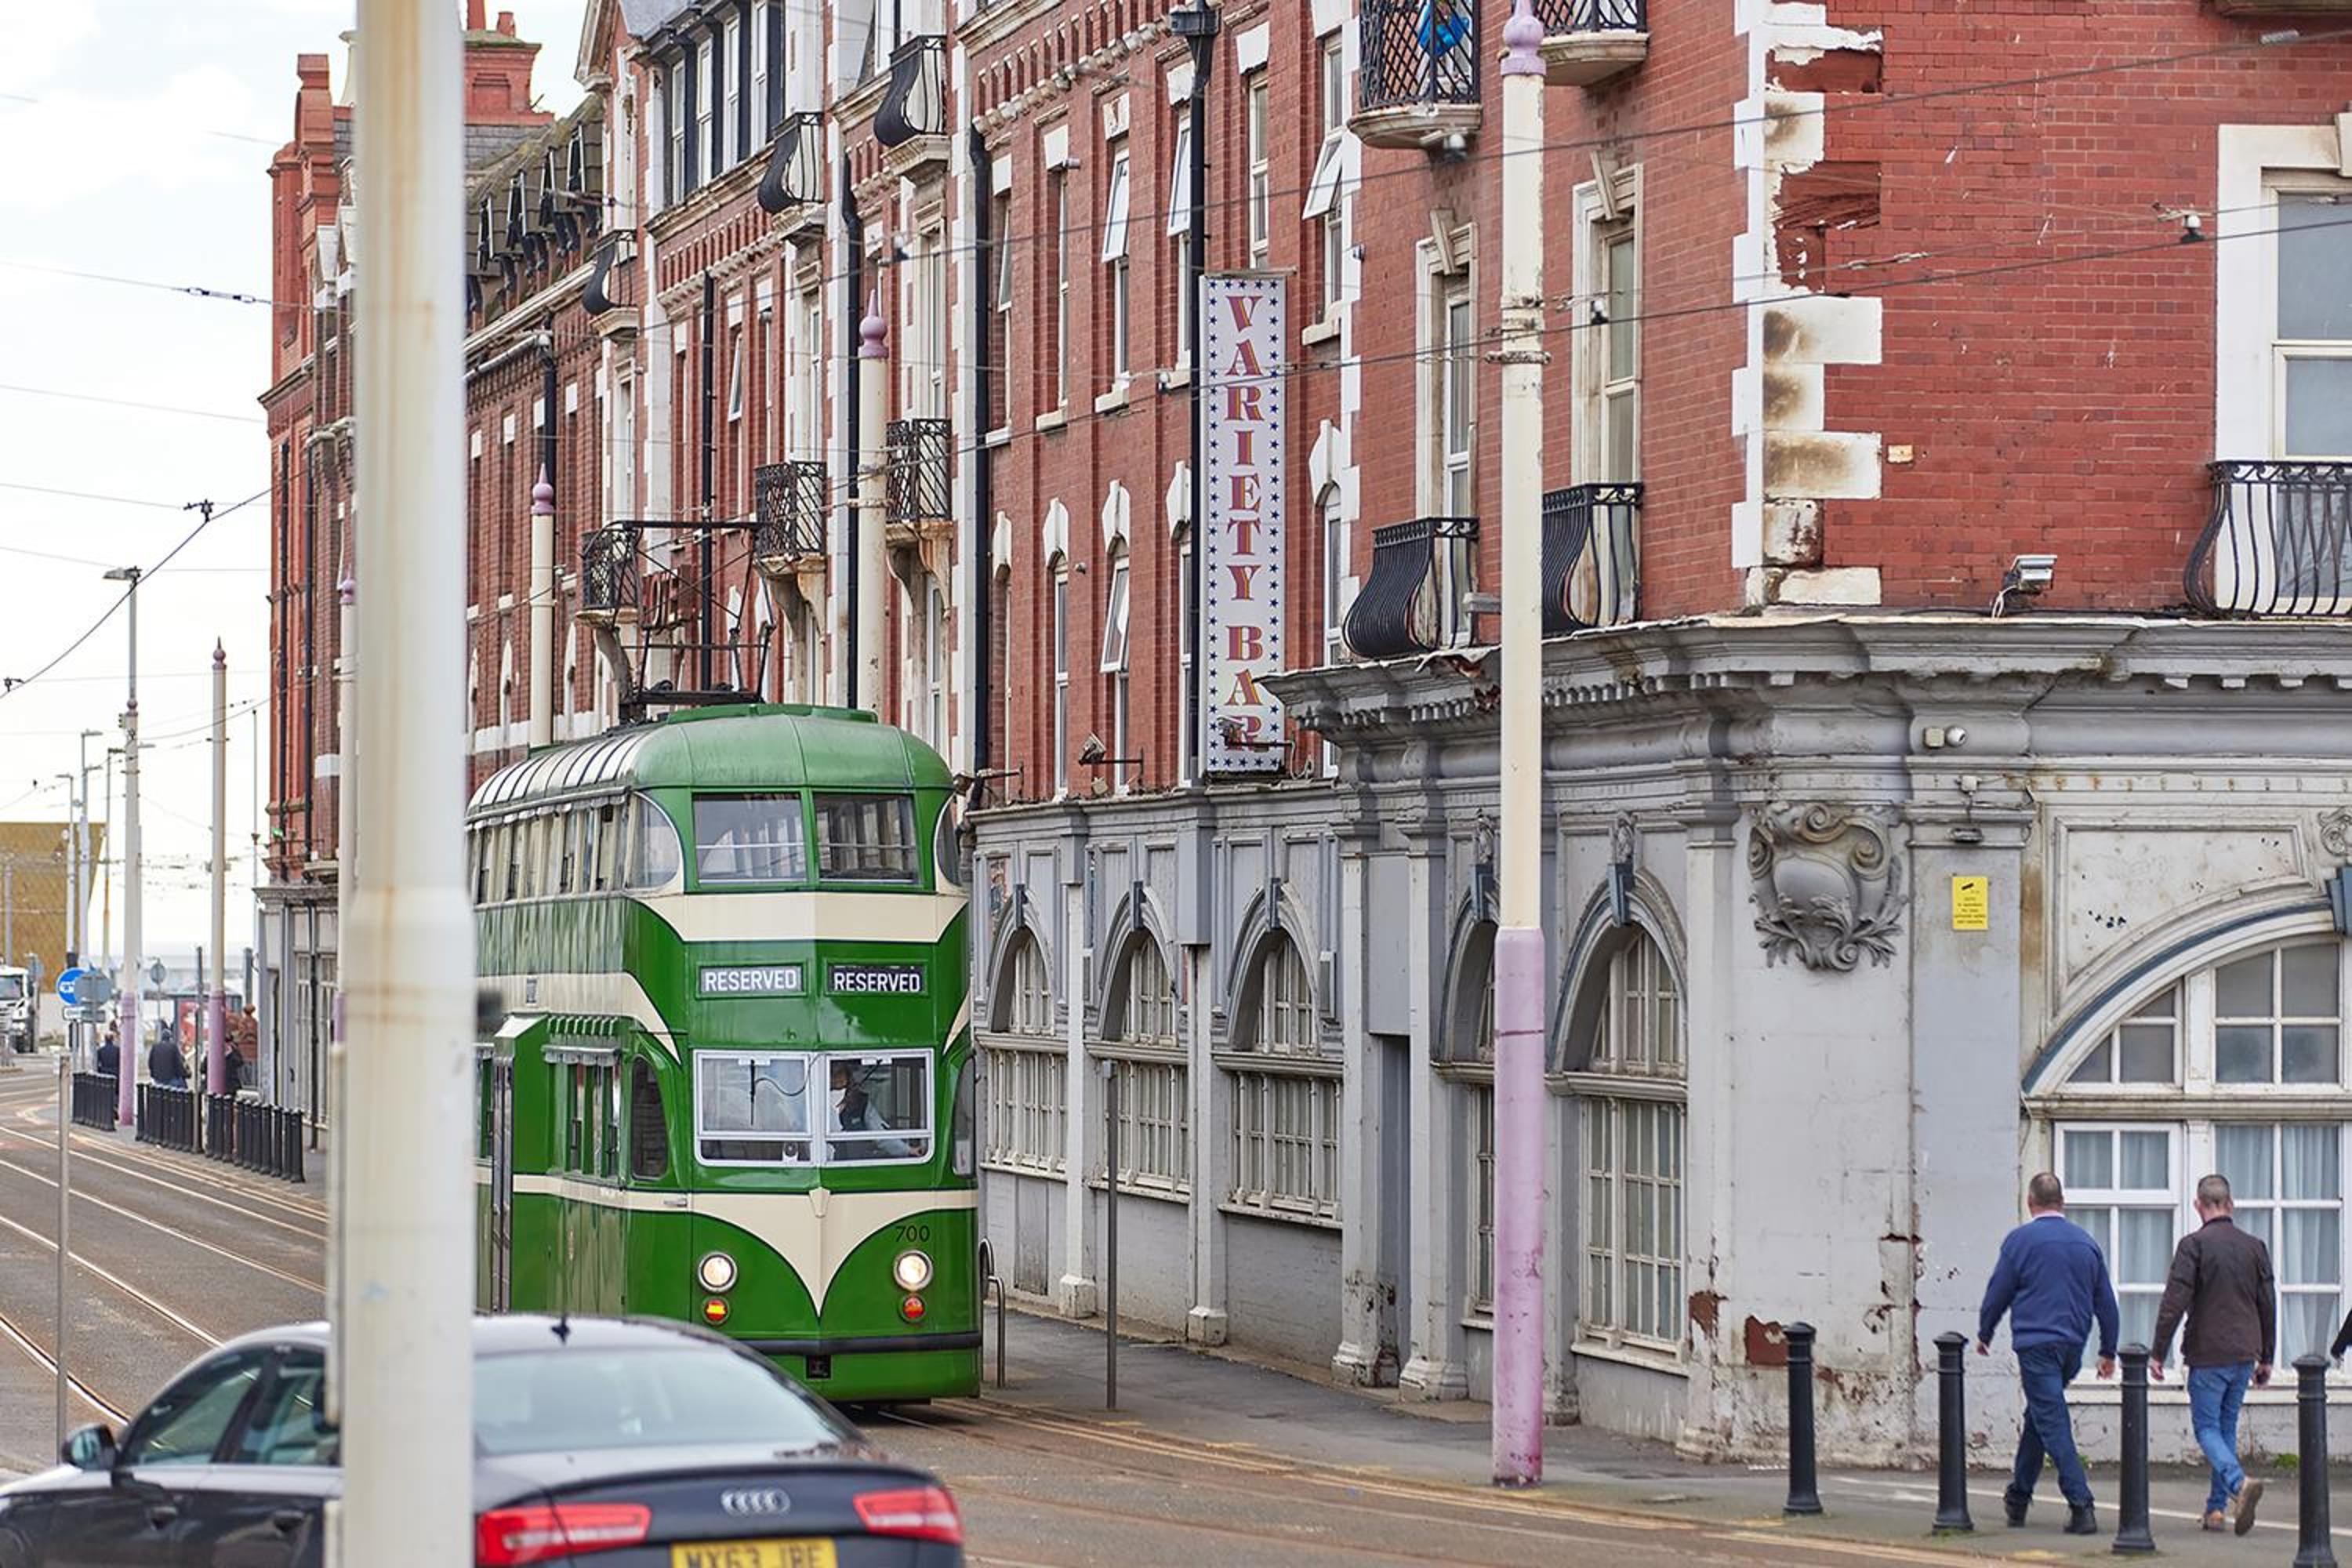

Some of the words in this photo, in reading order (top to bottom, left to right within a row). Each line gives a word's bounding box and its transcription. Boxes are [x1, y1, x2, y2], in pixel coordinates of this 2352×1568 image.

[1225, 295, 1265, 601] VARIETY
[705, 969, 797, 992] RESERVED
[833, 971, 920, 993] RESERVED
[895, 1225, 931, 1243] 700
